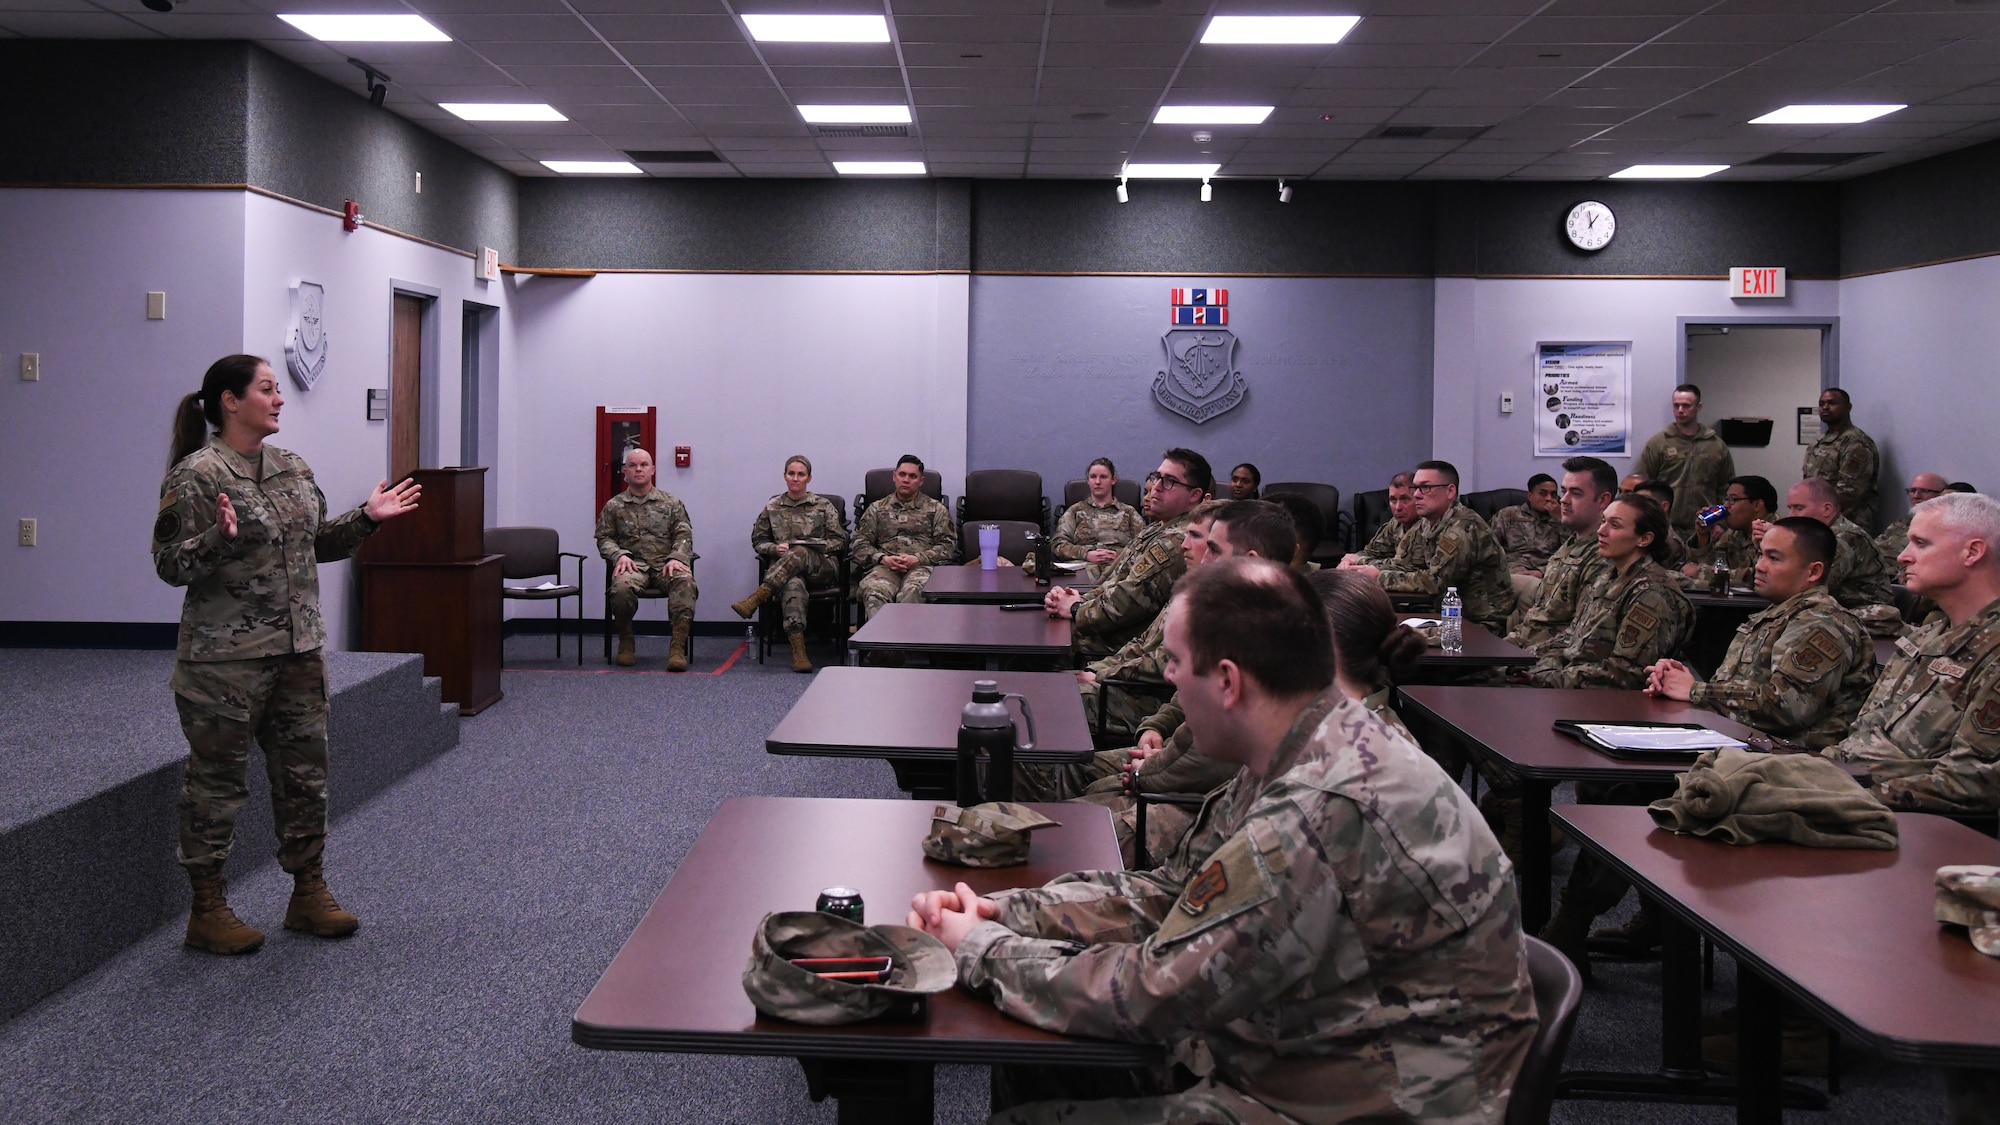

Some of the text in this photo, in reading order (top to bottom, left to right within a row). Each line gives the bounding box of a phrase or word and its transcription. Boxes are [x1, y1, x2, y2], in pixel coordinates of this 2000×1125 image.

[1573, 211, 1579, 219] 10
[1568, 220, 1574, 228] 9
[1608, 222, 1613, 230] 3
[1571, 230, 1577, 238] 8
[1604, 231, 1609, 239] 4
[1578, 236, 1584, 244] 7
[1587, 239, 1593, 247] 6
[1597, 237, 1602, 245] 5
[1743, 269, 1778, 294] EXIT
[1214, 388, 1240, 408] WING
[1151, 545, 1168, 562] FIRE
[1630, 610, 1656, 627] PORT
[1811, 634, 1841, 656] PORT
